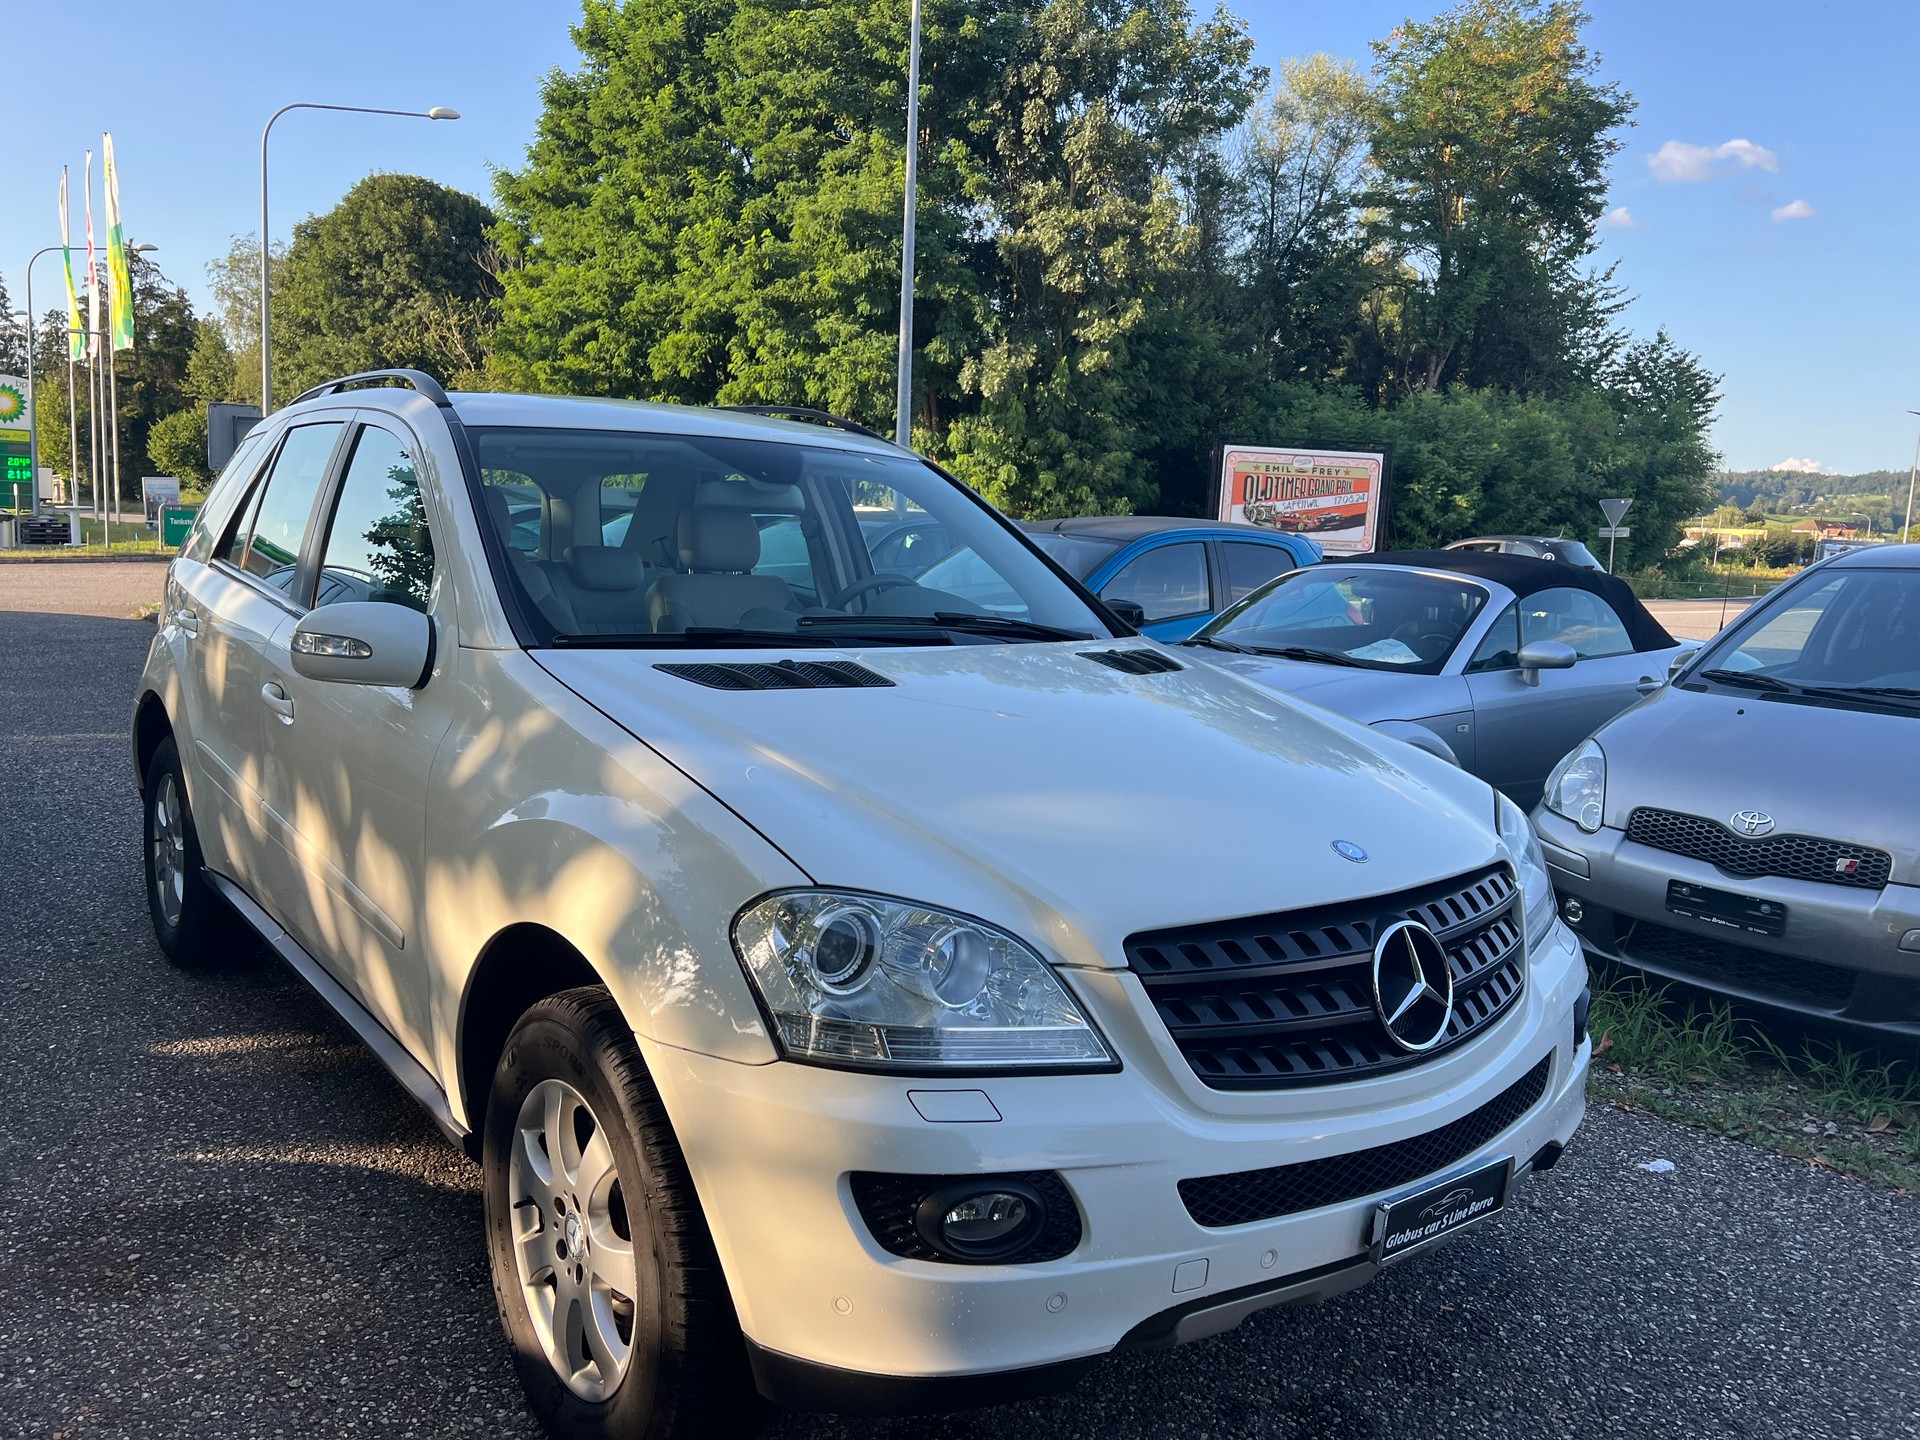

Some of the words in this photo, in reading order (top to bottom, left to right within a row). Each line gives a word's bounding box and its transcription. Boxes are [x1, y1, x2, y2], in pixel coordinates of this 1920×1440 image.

[15, 379, 28, 389] bp
[1265, 465, 1291, 473] EMIL
[1312, 467, 1341, 476] FREY
[1243, 475, 1306, 502] OLDTIMER
[1308, 478, 1335, 496] GRAND
[1337, 480, 1353, 493] PRIX
[1385, 1227, 1424, 1249] Globus
[1424, 1220, 1441, 1235] car
[1441, 1214, 1449, 1229] S
[1448, 1208, 1468, 1225] Line
[1468, 1196, 1494, 1216] Berro
